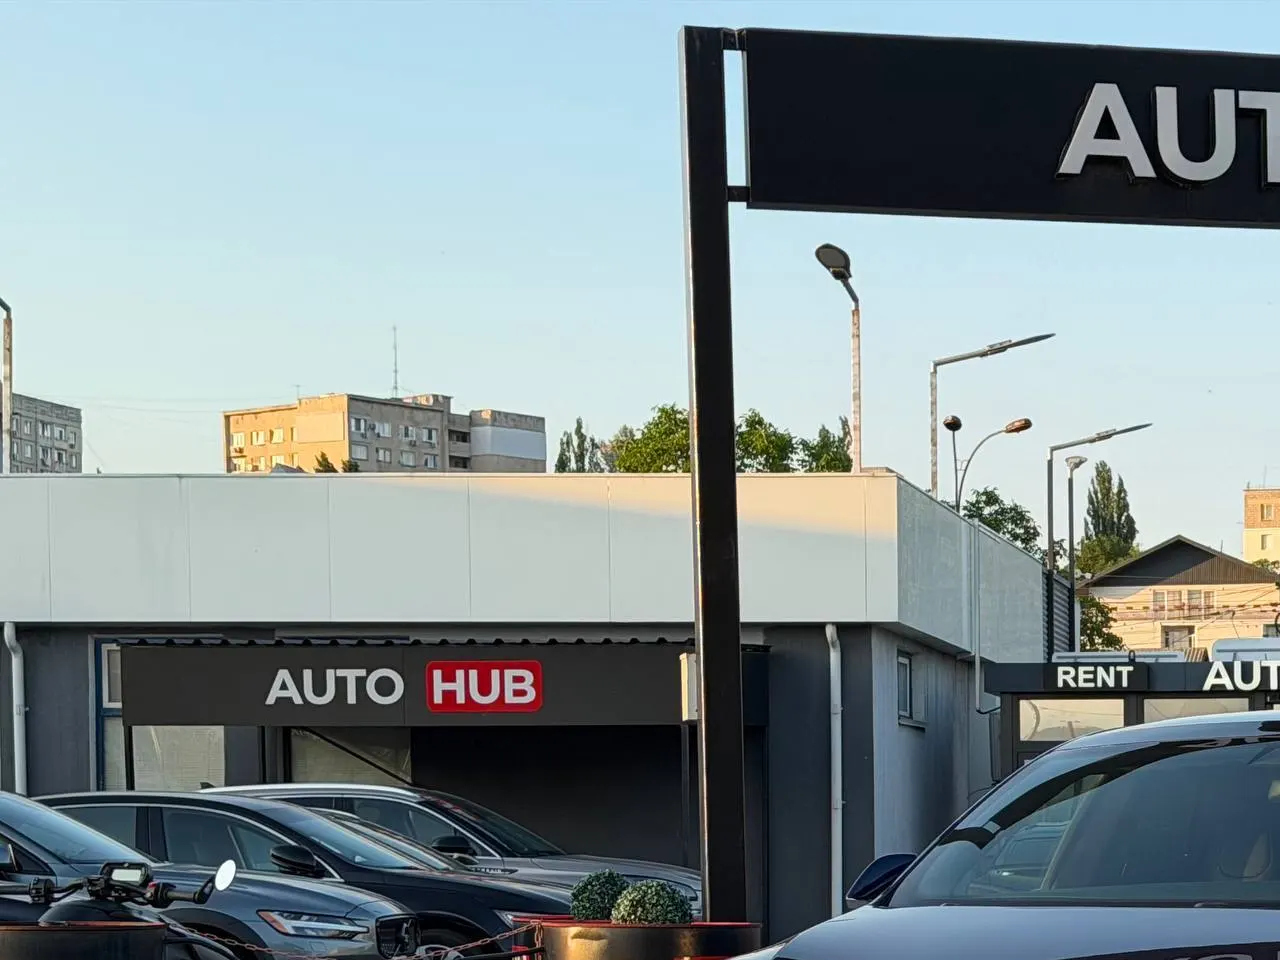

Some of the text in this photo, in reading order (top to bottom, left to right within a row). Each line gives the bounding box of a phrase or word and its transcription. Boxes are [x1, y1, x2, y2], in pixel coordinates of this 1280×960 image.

[264, 667, 537, 706] AUTO HUB
[1056, 665, 1134, 689] RENT
